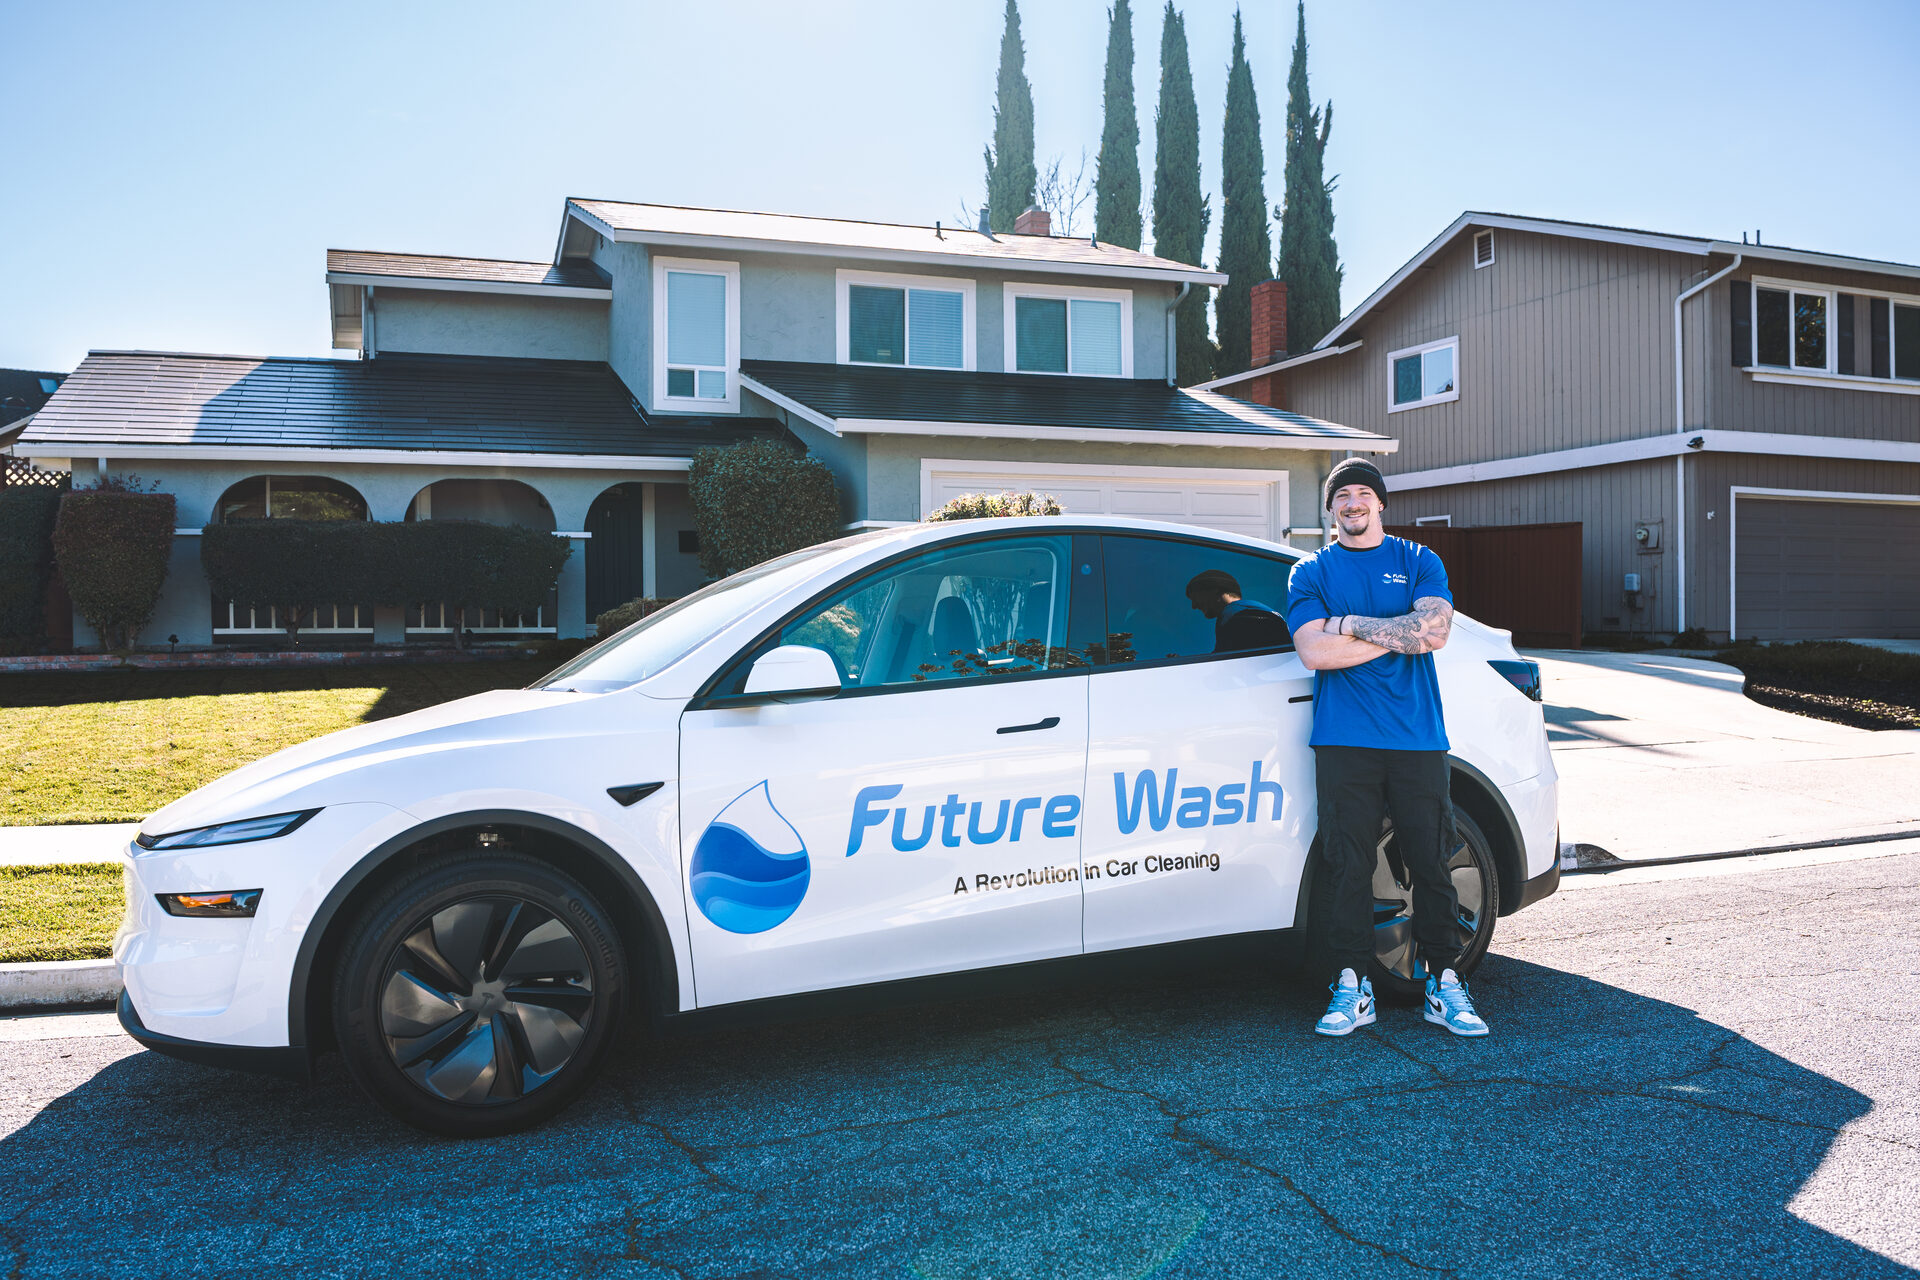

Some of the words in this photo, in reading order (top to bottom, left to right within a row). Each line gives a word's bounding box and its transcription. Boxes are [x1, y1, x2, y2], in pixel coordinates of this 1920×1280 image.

[845, 784, 1082, 858] Future
[1113, 760, 1284, 835] Wash
[953, 876, 969, 896] A
[975, 865, 1079, 892] Revolution
[1084, 862, 1101, 880] in
[1106, 859, 1138, 878] Car
[1144, 852, 1220, 872] Cleaning
[567, 898, 618, 969] Continental
